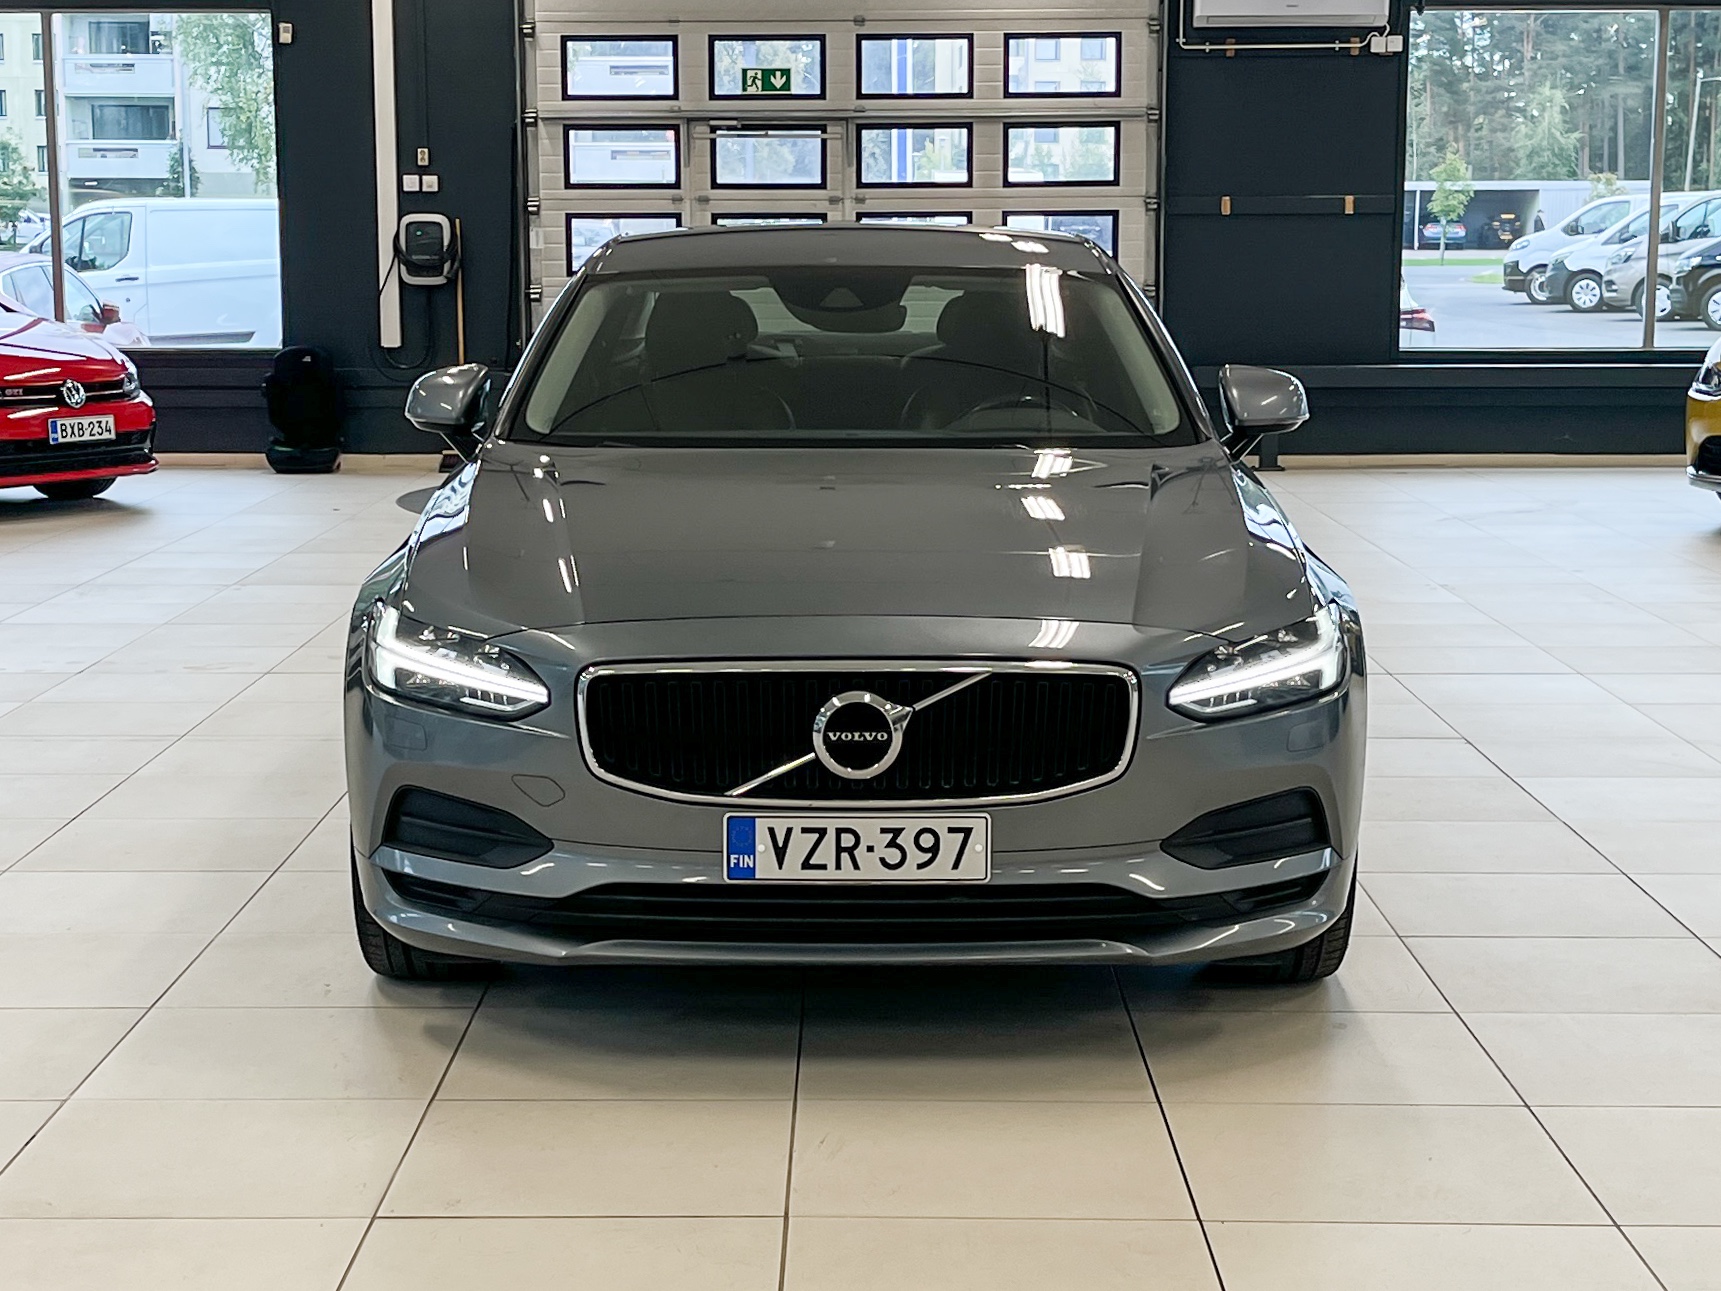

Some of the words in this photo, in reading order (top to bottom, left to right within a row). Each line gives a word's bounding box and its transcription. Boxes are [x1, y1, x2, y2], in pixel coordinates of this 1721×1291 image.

[5, 388, 24, 396] GTI
[60, 420, 112, 439] BXB-234
[827, 731, 888, 741] VOLVO
[767, 826, 974, 871] VZR-397
[730, 854, 754, 868] FIN
